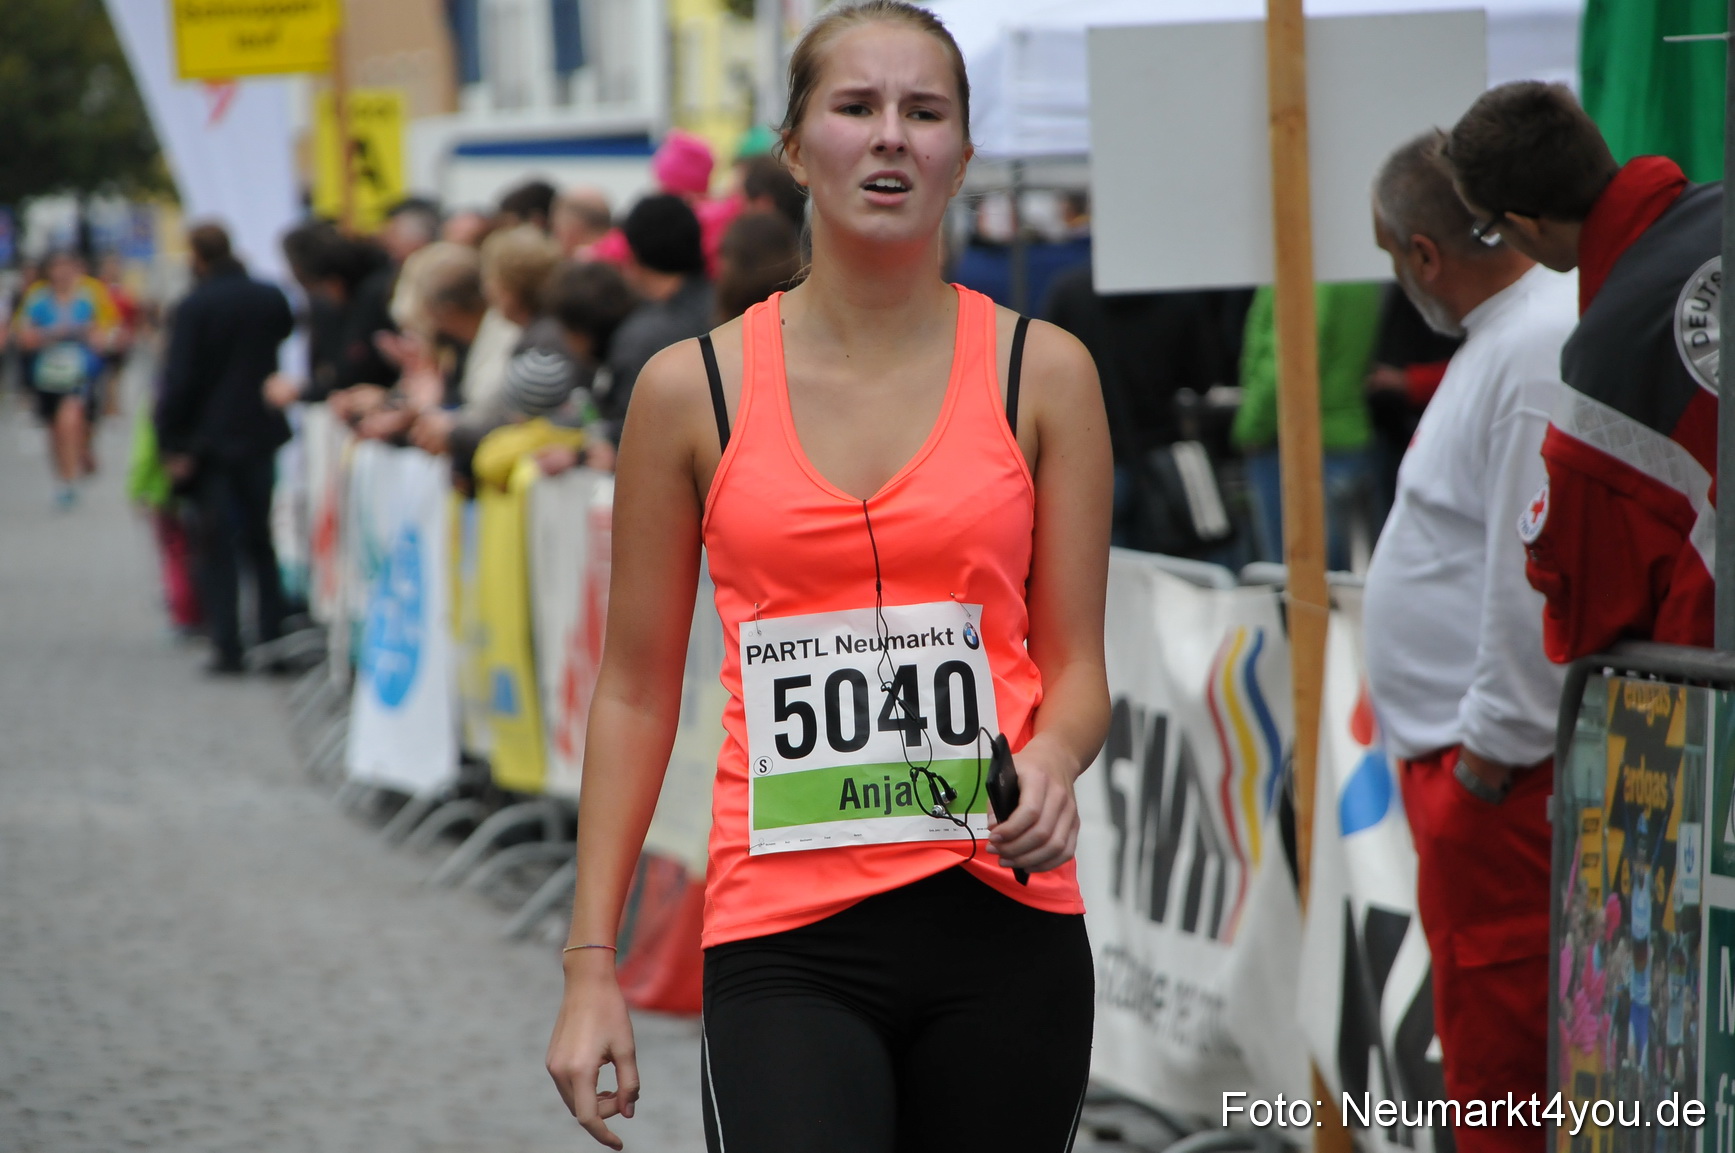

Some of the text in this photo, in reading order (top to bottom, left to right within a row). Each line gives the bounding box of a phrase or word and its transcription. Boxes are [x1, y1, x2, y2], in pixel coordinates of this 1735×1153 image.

[746, 637, 829, 666] PARTL
[835, 626, 955, 655] Neumarkt
[773, 659, 980, 760] 5040
[838, 775, 914, 816] Anja
